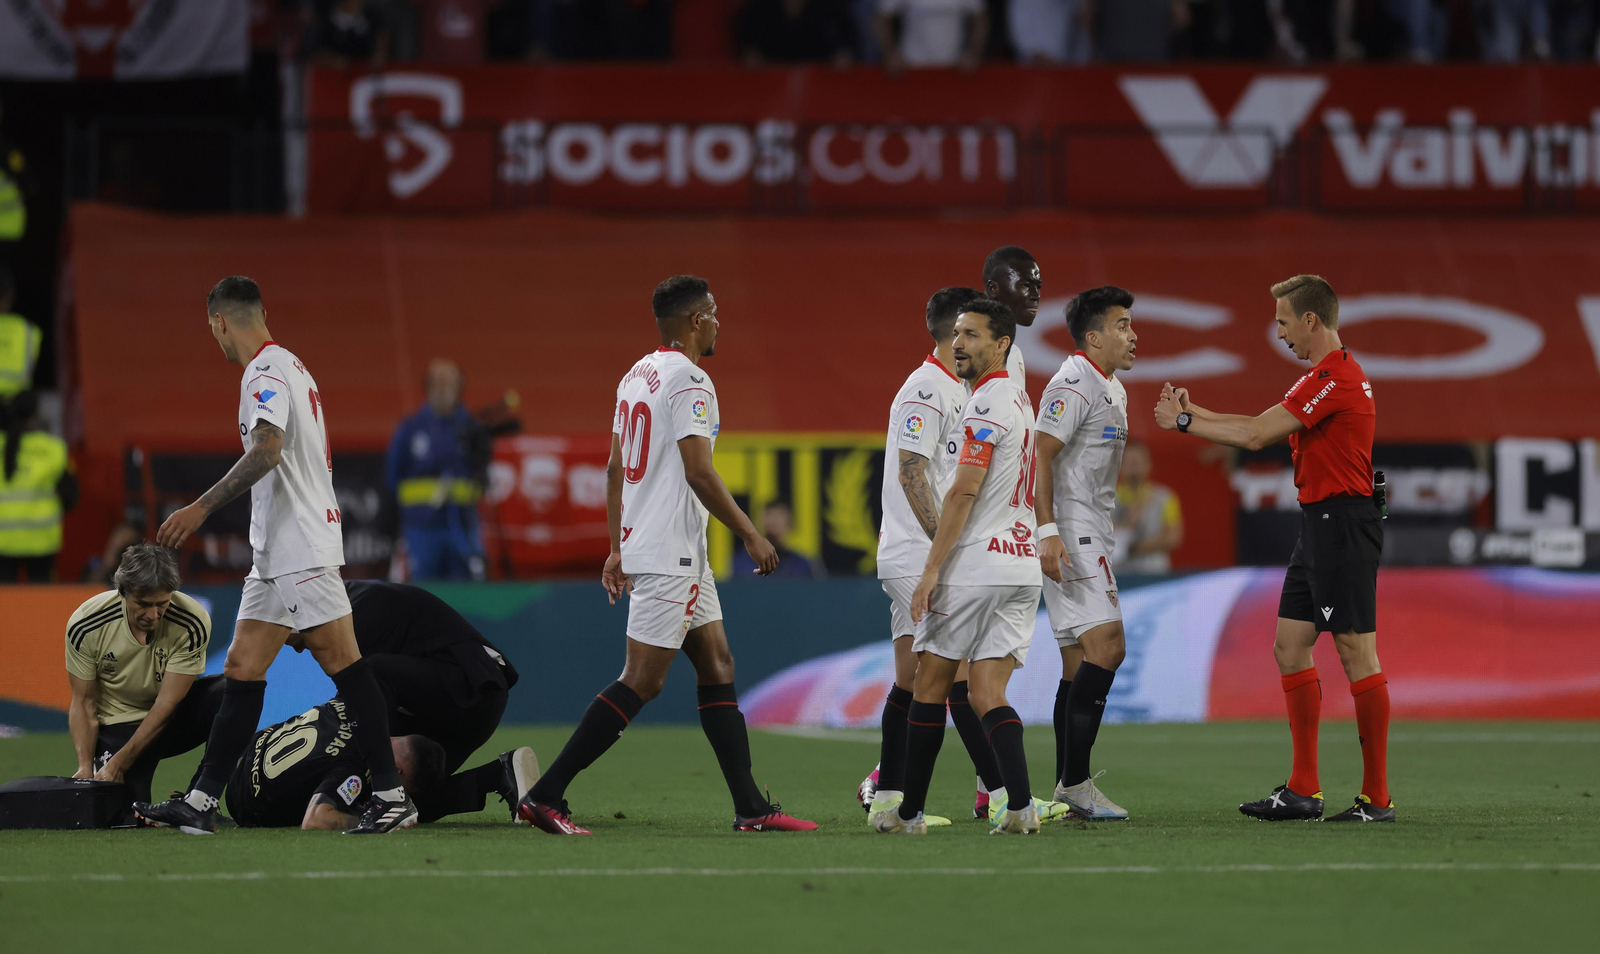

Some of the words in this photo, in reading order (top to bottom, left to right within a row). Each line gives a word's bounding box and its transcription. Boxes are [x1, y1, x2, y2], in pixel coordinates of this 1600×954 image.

[623, 363, 660, 394] FERNANDO
[1044, 413, 1059, 423] LaLiga
[903, 430, 920, 440] LaLiga
